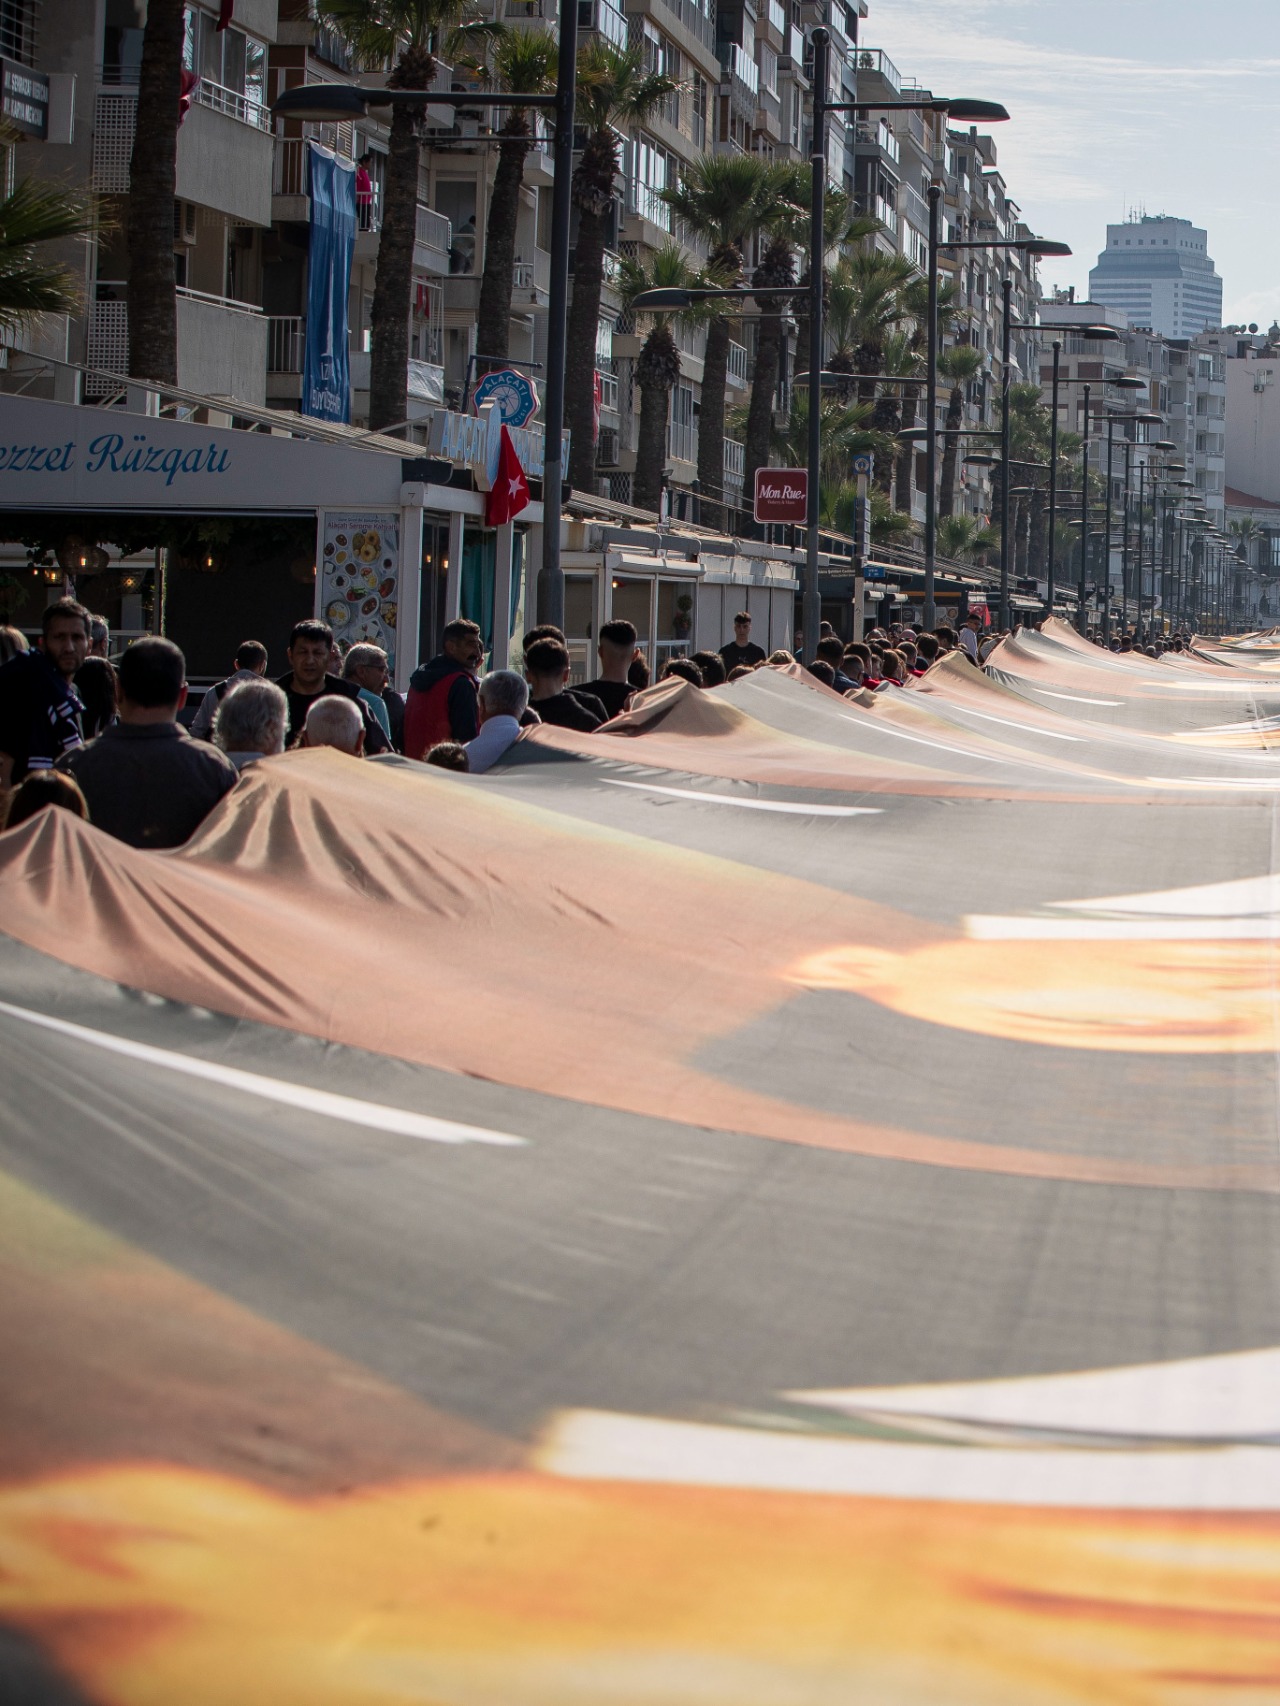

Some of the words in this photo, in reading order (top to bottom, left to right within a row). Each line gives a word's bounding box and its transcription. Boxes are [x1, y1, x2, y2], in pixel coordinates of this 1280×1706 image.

[484, 375, 528, 397] ALAÇATI
[0, 441, 77, 473] ezzet
[759, 484, 781, 500] Mon
[781, 484, 802, 501] Rue
